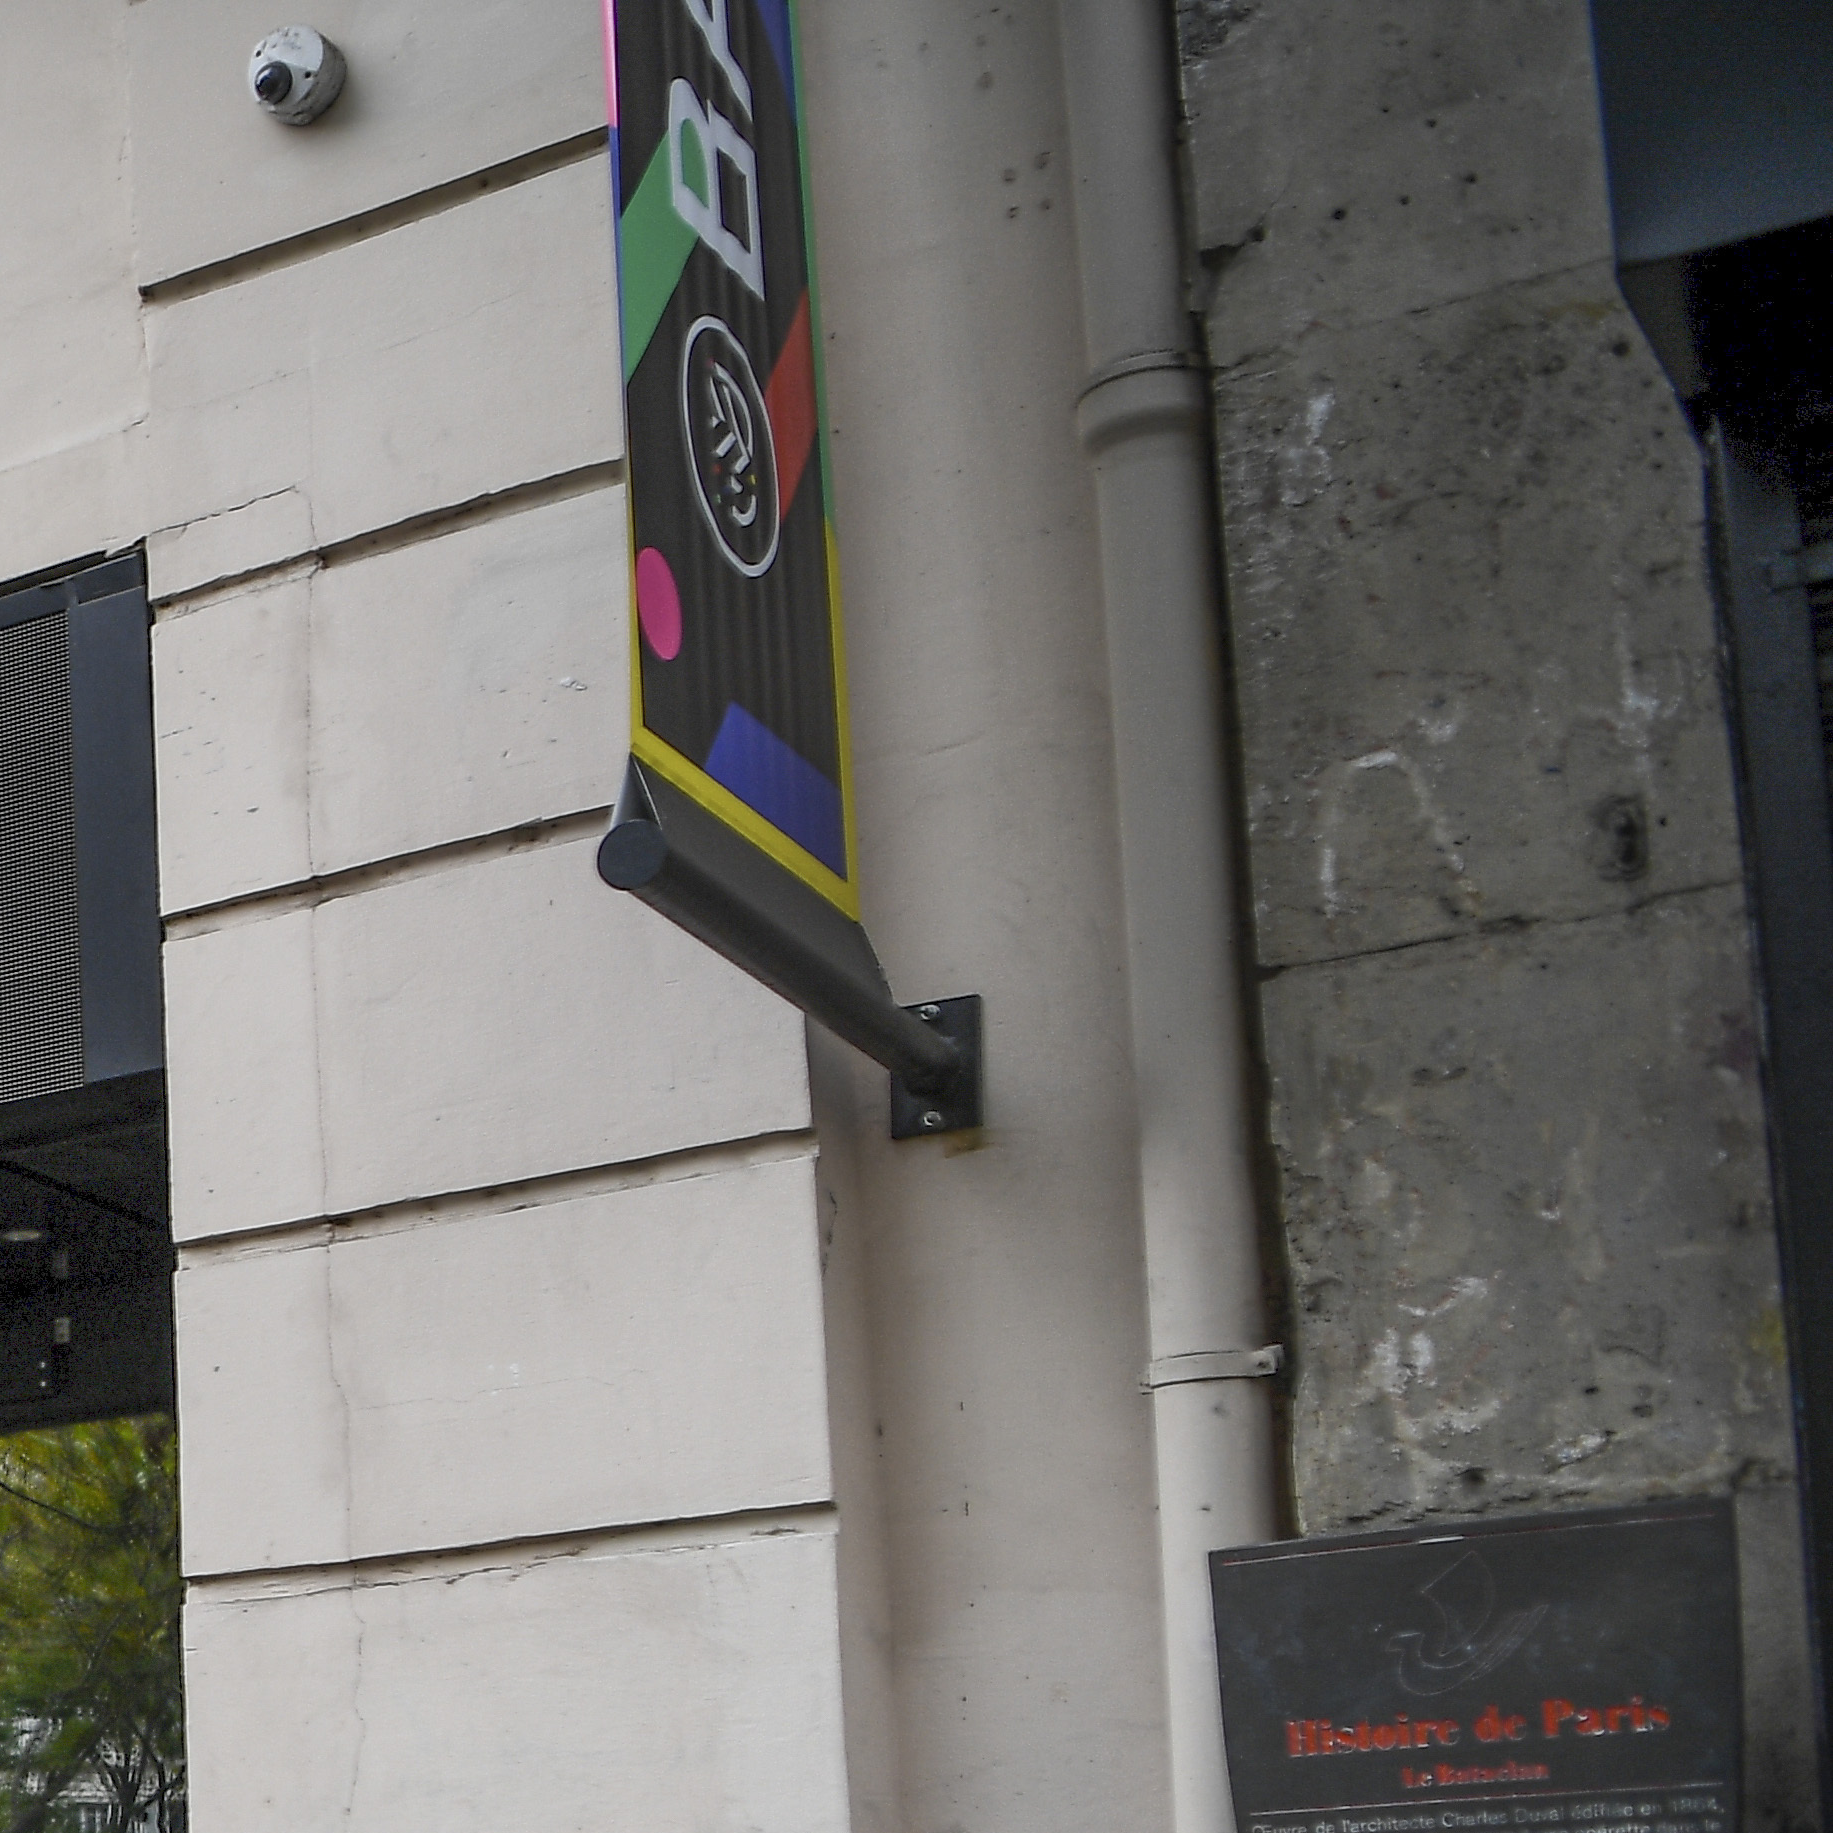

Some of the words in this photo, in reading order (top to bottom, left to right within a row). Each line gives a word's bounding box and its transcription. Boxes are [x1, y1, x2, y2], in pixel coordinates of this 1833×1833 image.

[1287, 1714, 1460, 1757] Histoire
[1474, 1704, 1526, 1743] de
[1541, 1697, 1669, 1739] Paris
